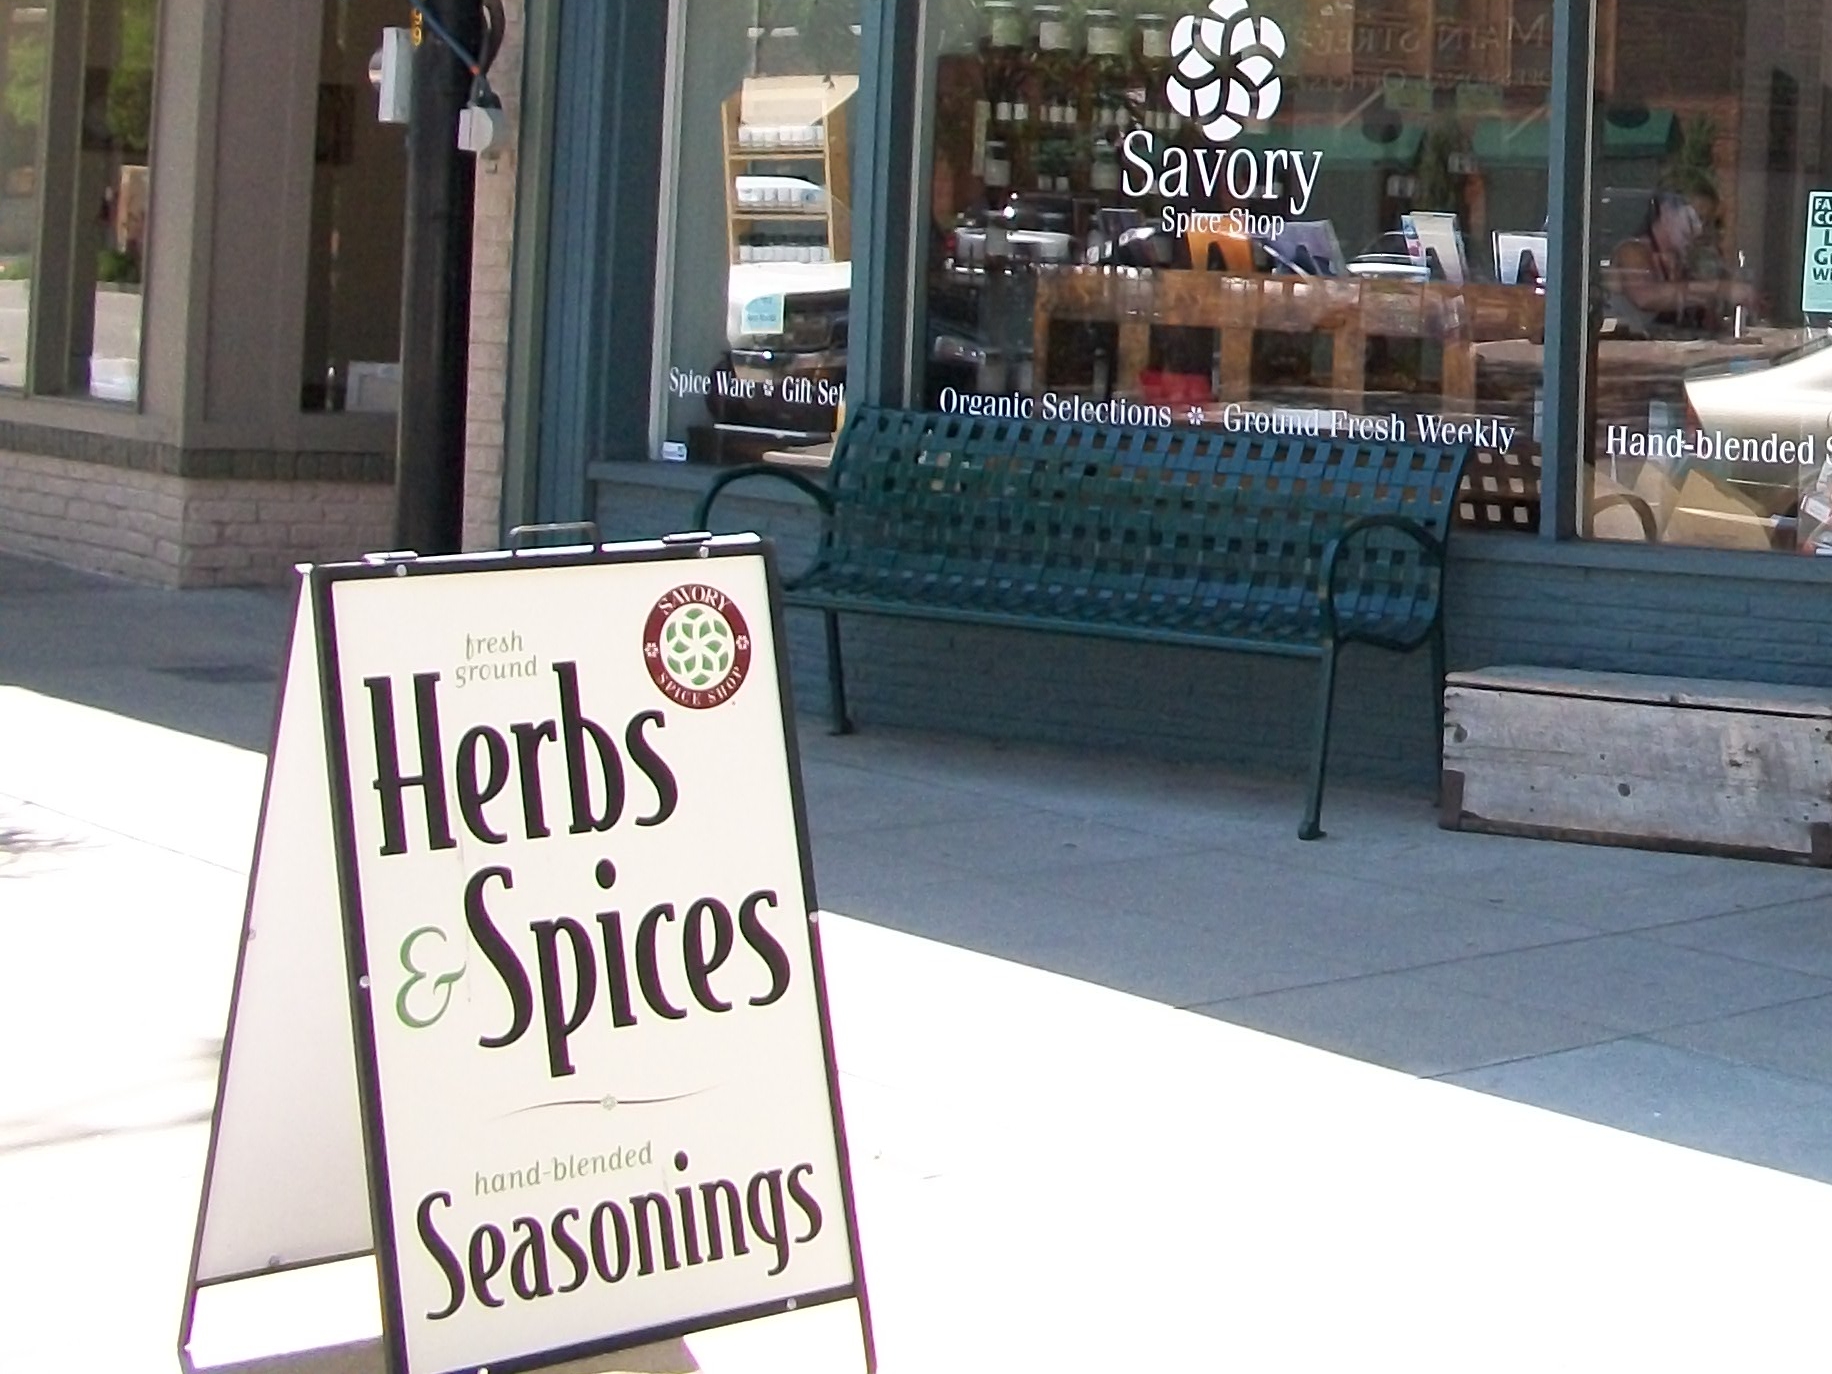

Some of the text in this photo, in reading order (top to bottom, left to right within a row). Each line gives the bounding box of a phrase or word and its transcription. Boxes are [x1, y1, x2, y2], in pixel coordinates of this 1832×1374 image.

[1120, 129, 1324, 216] Savory
[1161, 205, 1286, 241] Spice Shop
[669, 366, 711, 398] Spice
[715, 370, 756, 399] Ware
[781, 376, 813, 404] Gift
[938, 386, 1516, 455] Organic Selections Ground Fresh Weekly
[1604, 425, 1815, 465] Hand-blended
[659, 586, 731, 615] SAVORY
[466, 629, 523, 660] fresh
[455, 655, 537, 688] ground
[660, 666, 742, 705] SPICE SHOP
[363, 661, 679, 857] Herbs
[395, 858, 791, 1078] & Spices
[473, 1141, 653, 1197] hand-blended
[416, 1150, 823, 1321] Seasonings
